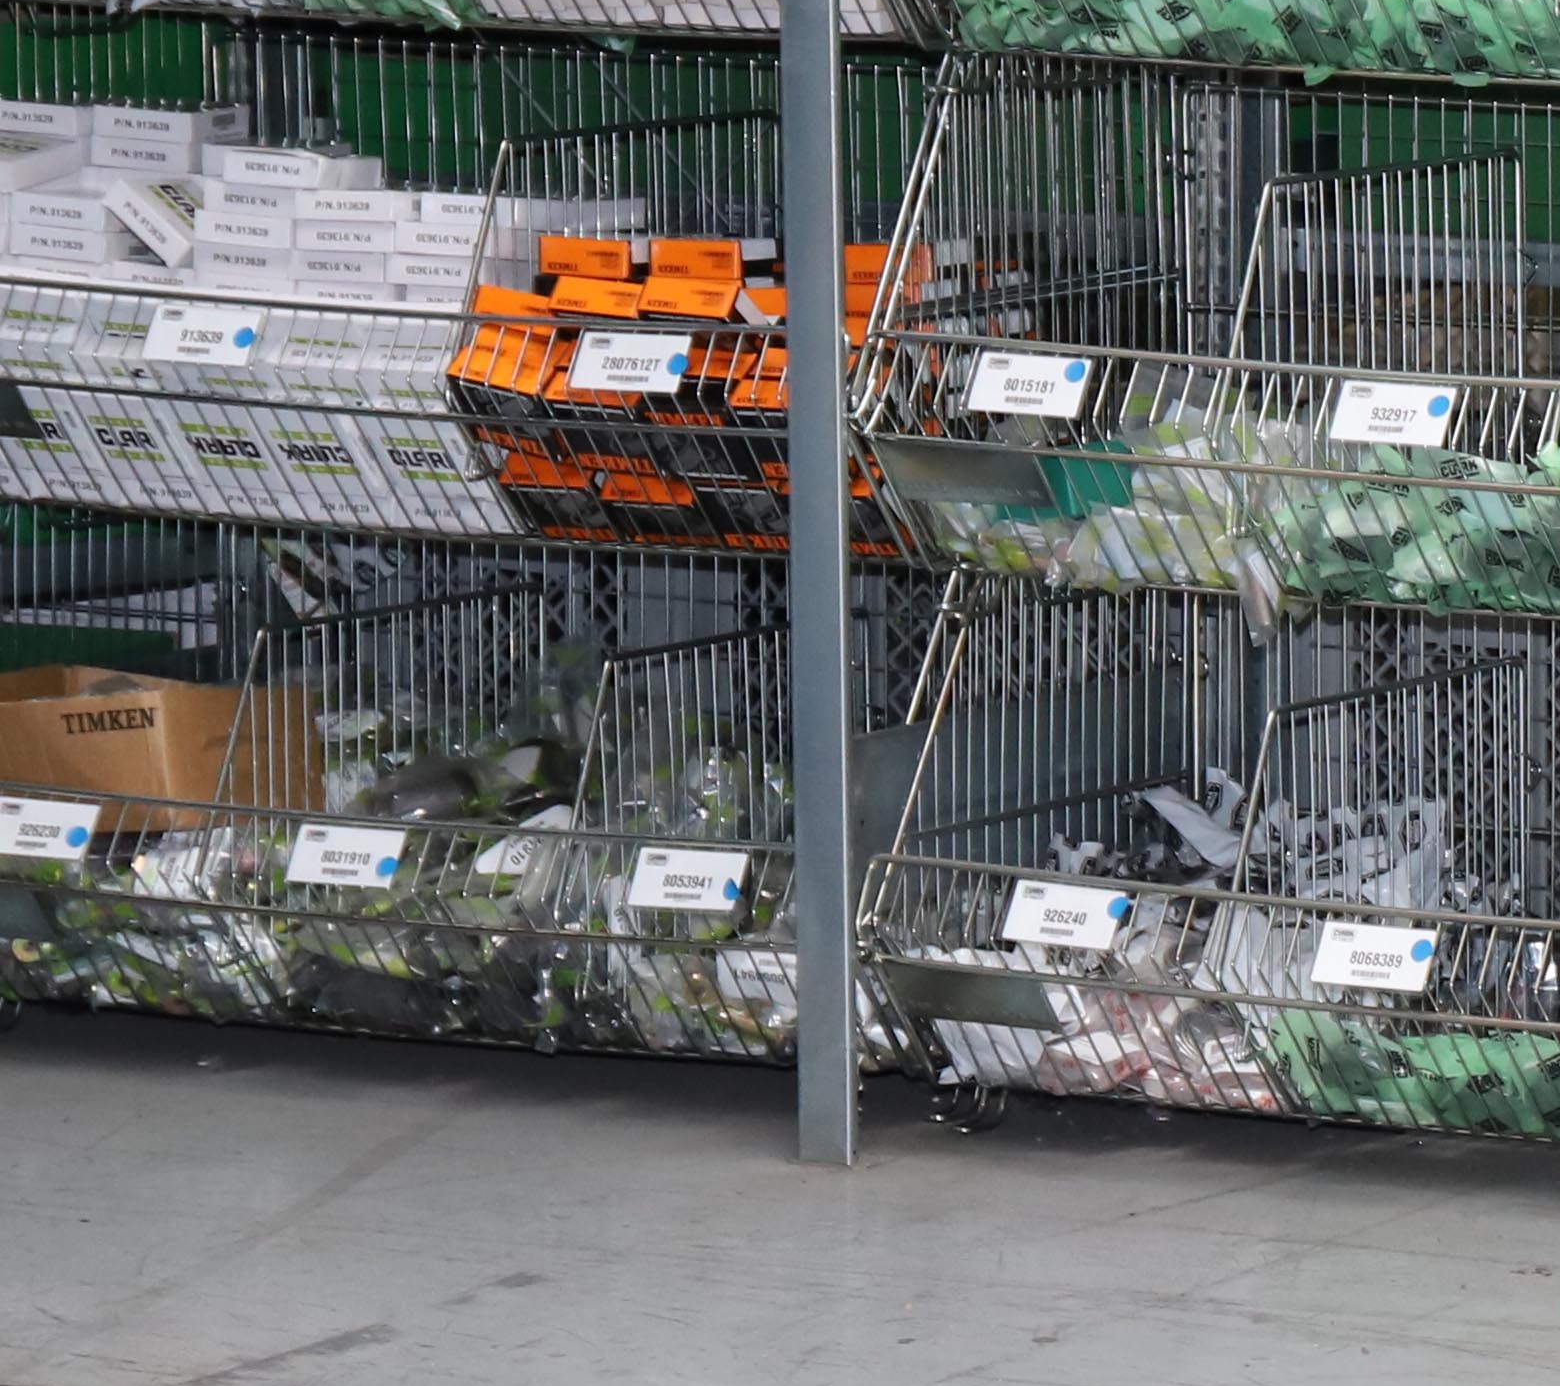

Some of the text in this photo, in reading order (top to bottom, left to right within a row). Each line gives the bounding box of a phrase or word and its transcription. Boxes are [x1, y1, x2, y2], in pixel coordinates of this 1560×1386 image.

[180, 329, 222, 344] 913639
[601, 356, 660, 372] 2807612T
[1003, 377, 1056, 395] 8015181
[1371, 407, 1417, 423] 932917
[61, 707, 155, 735] TIMKEN
[321, 850, 371, 865] 8031910
[662, 874, 713, 890] 8053941
[1043, 909, 1087, 926] 926240
[1350, 950, 1403, 967] 8068389
